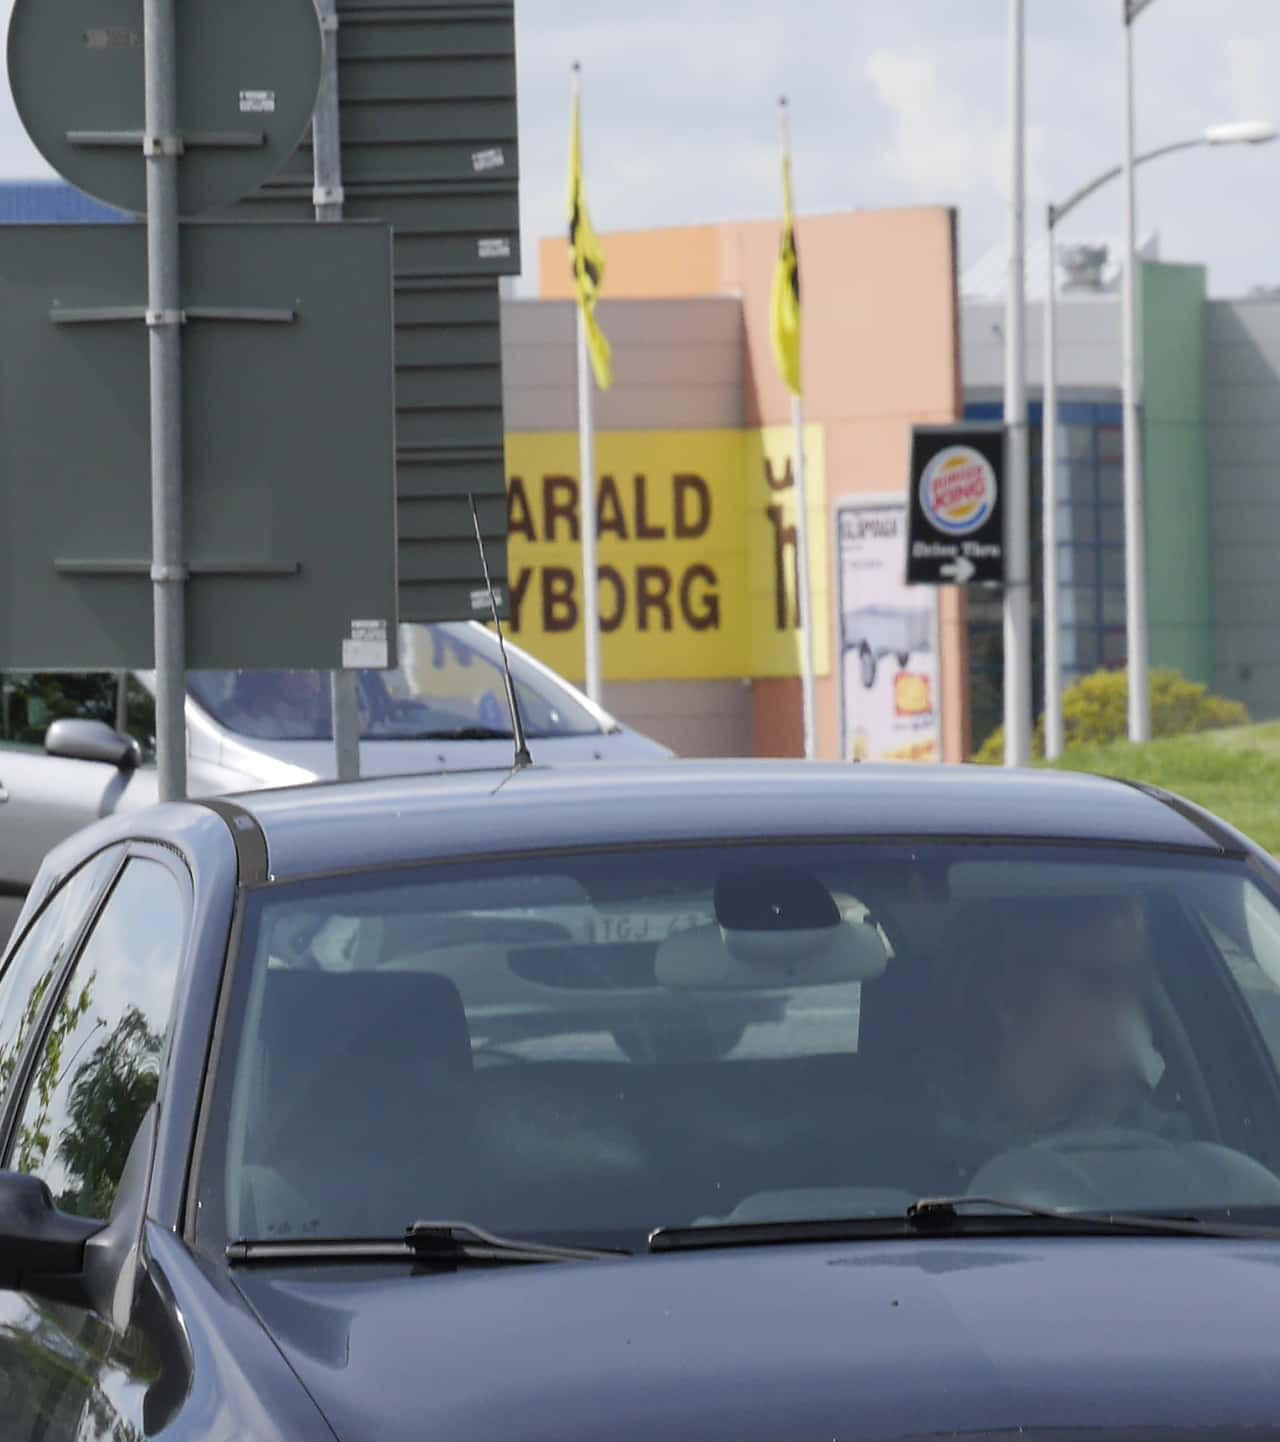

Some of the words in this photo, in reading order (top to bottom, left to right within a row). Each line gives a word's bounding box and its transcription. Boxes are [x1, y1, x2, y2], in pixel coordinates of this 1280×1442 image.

[507, 474, 711, 541] ARALD
[932, 479, 986, 512] KING
[510, 564, 721, 634] YBORG
